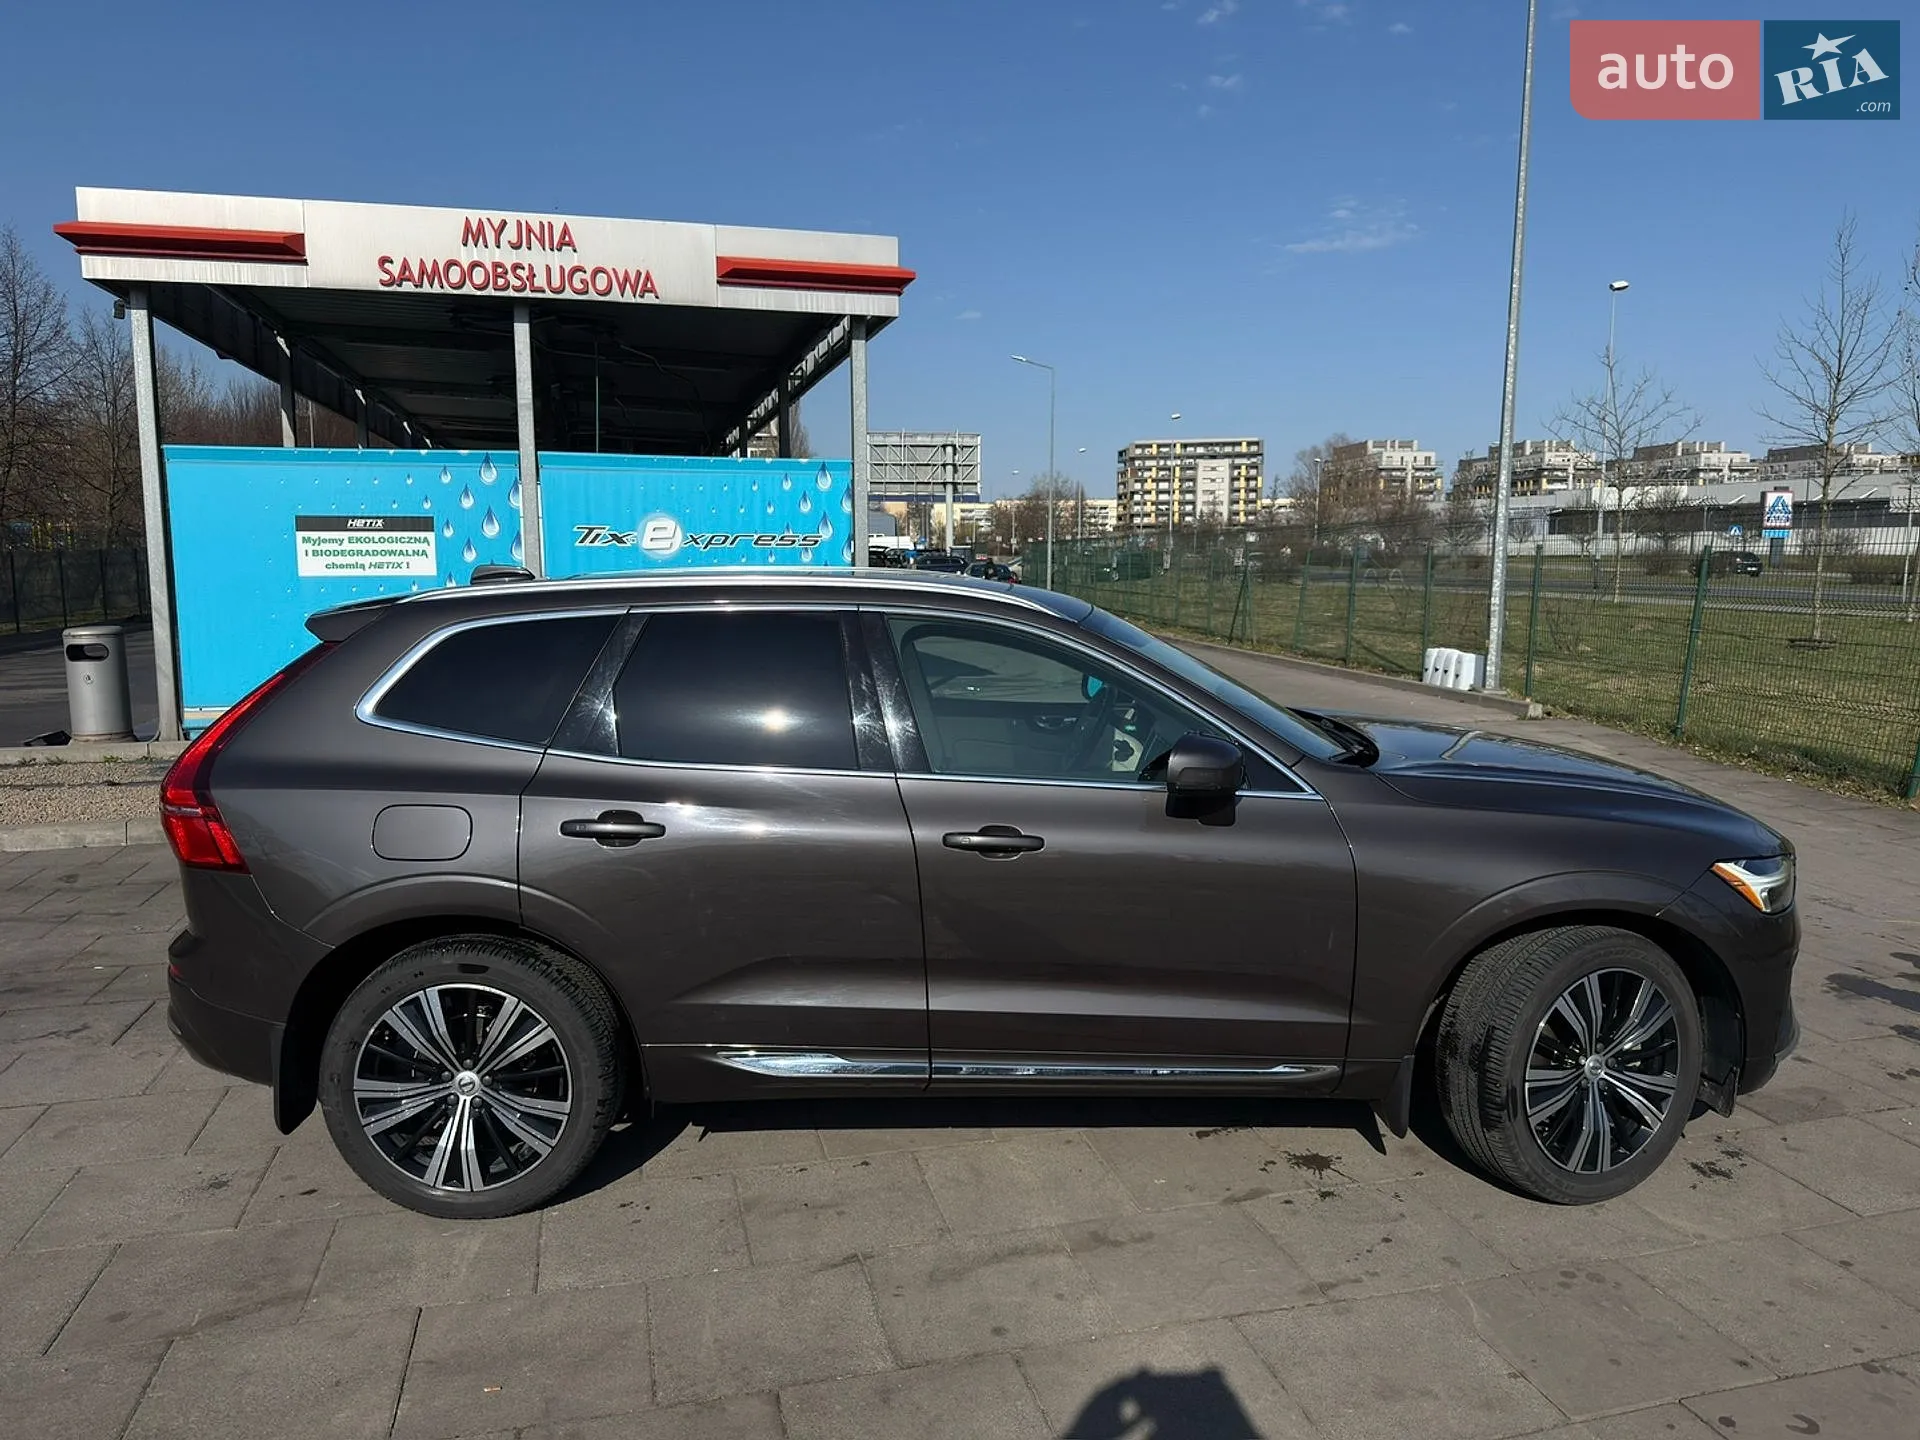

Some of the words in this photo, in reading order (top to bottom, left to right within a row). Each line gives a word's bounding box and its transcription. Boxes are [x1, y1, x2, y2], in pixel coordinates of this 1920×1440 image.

[461, 216, 578, 252] MYJNIA
[377, 255, 660, 299] SAMOOBSŁUGOWA
[301, 536, 345, 547] Myjemy
[347, 536, 430, 546] EKOLOGICZNĄ
[311, 549, 429, 558] BIODEGRADOWALNĄ
[325, 561, 366, 571] chemią
[368, 561, 404, 570] HETIX
